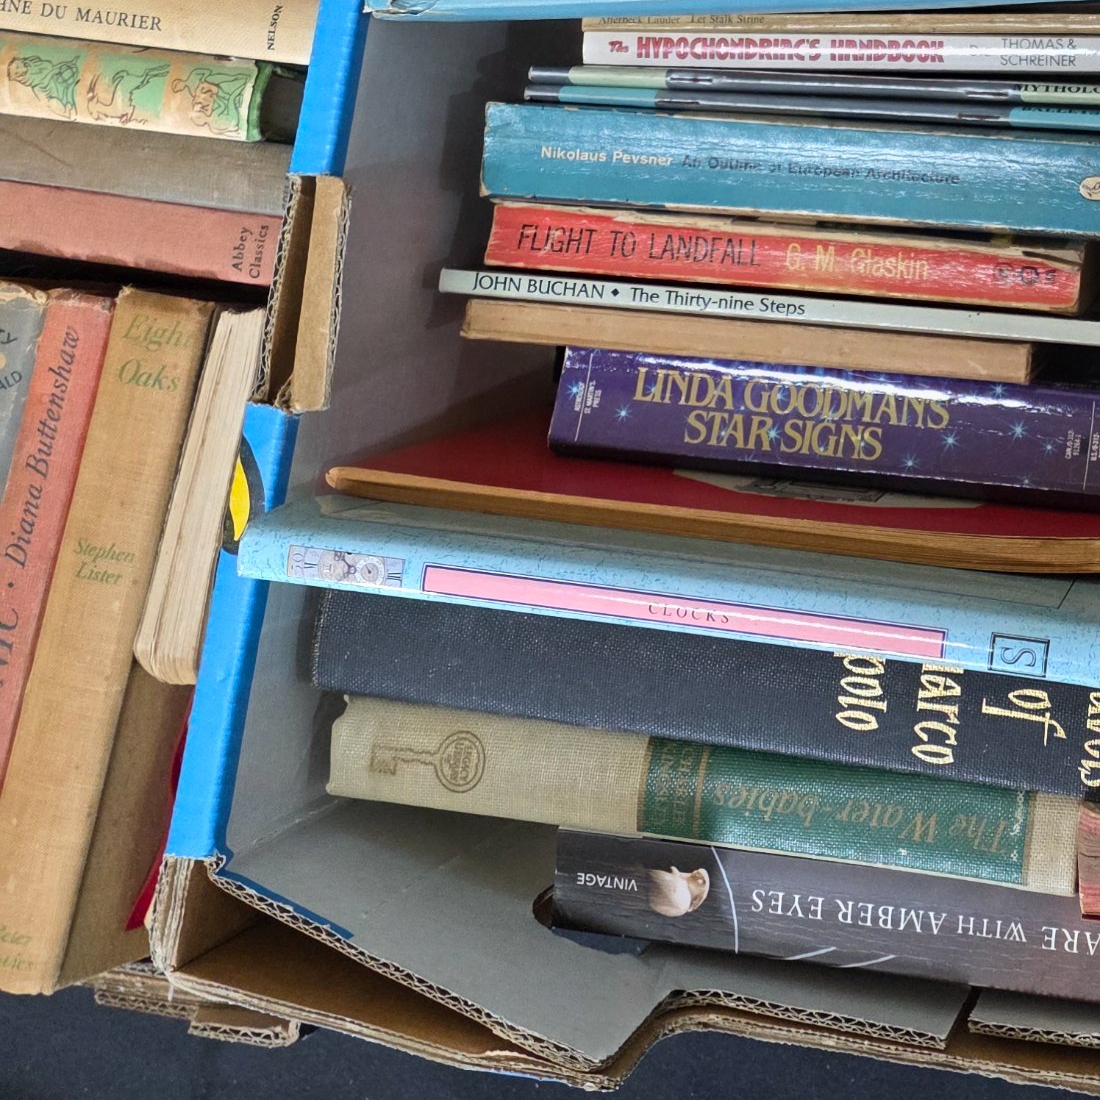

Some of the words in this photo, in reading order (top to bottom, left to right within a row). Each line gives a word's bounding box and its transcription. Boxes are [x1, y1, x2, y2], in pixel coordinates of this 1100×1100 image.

[40, 4, 67, 20] DU
[75, 7, 162, 32] MAURIER
[266, 5, 284, 51] NELSON
[1000, 38, 1064, 51] THOMAS
[1000, 54, 1077, 67] SCHREINER
[541, 146, 607, 163] Nikolaus
[612, 149, 674, 166] Pevsner
[231, 226, 252, 272] Abbey
[248, 224, 269, 279] Classics
[518, 224, 596, 256] FLIGHT
[609, 230, 637, 257] TO
[648, 233, 761, 268] LANDFALL
[471, 272, 521, 293] JOHN
[527, 279, 605, 299] BUCHAN
[631, 288, 660, 304] The
[665, 290, 754, 314] Thirty-nine
[760, 297, 806, 317] Steps
[118, 357, 181, 393] Oaks
[632, 367, 734, 412] LINDA
[4, 482, 44, 570] Diana
[26, 326, 81, 477] Buttenshaw
[684, 414, 772, 451] STAR
[779, 423, 884, 461] SIGNS
[648, 602, 731, 625] CLOCKS
[981, 687, 1068, 747] of
[576, 872, 638, 893] VINTAGE
[750, 887, 825, 921] EYES
[837, 898, 947, 936] AMBER
[957, 914, 1027, 943] WITH
